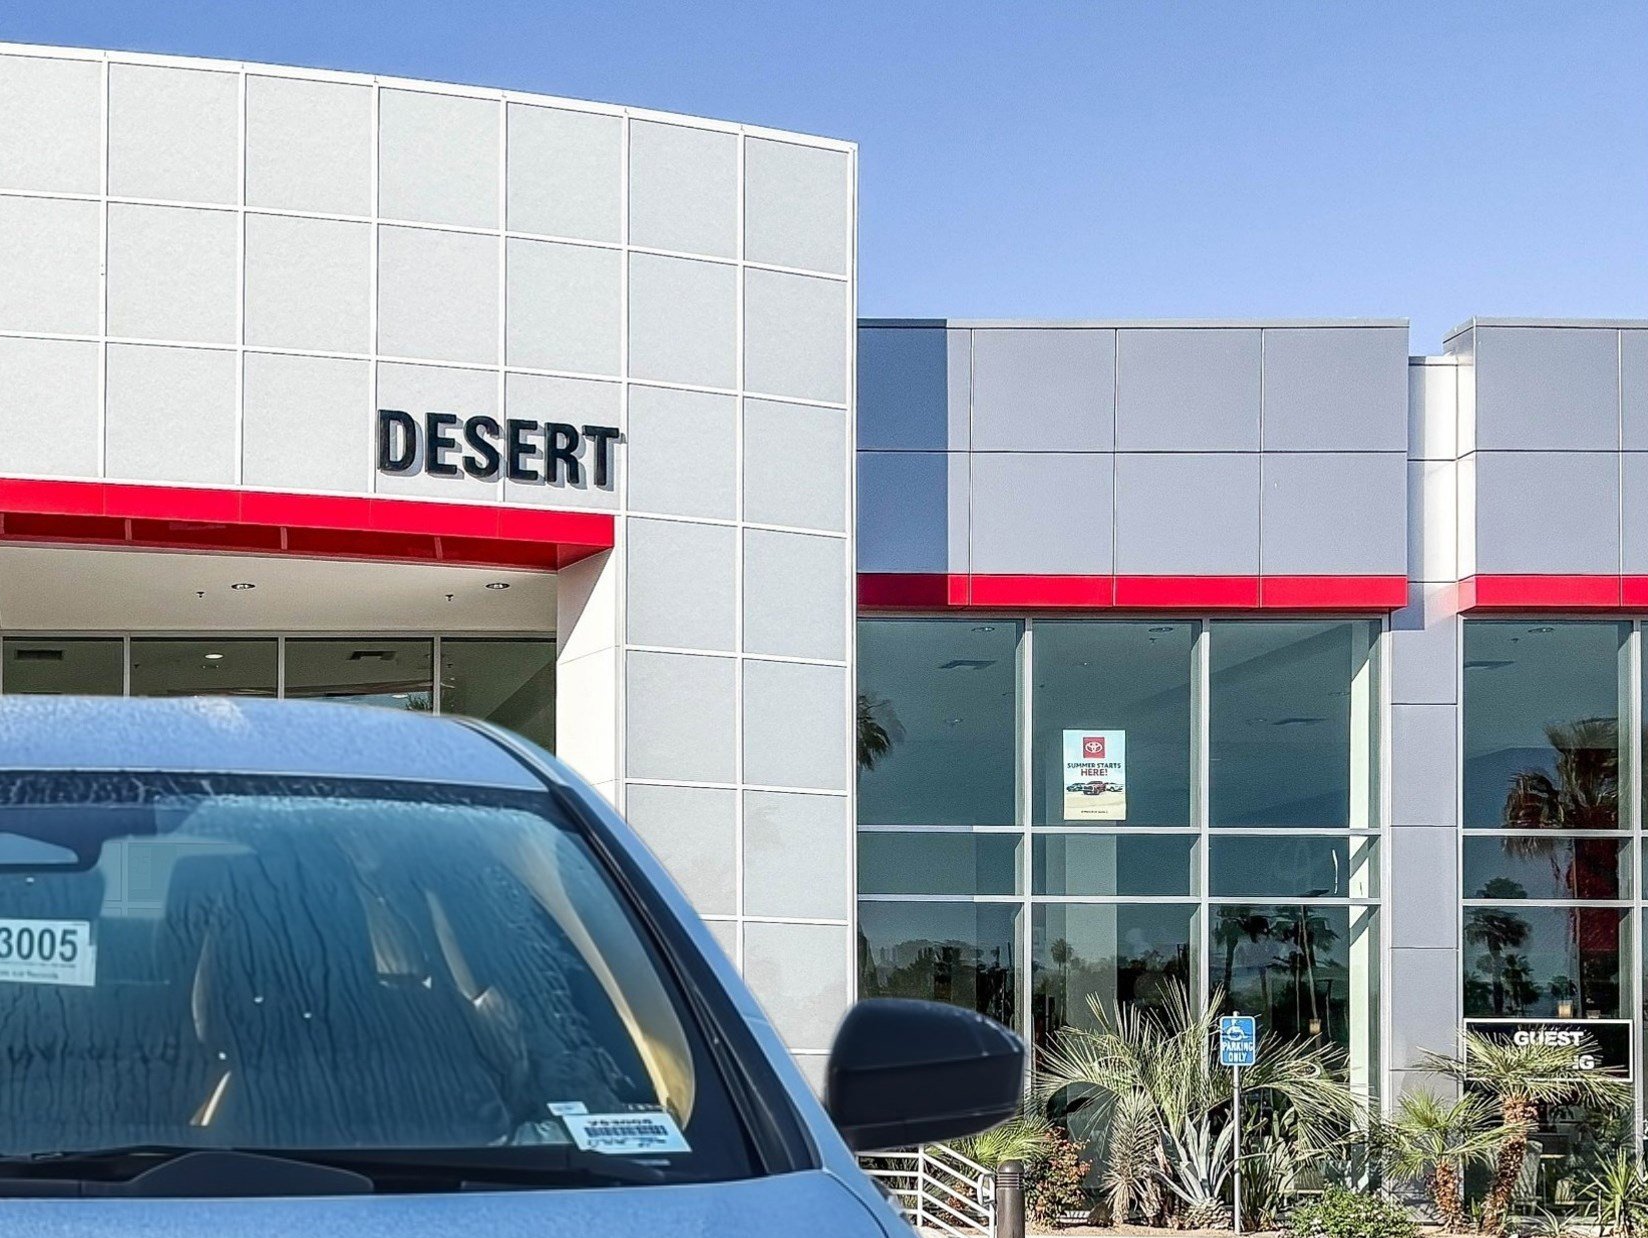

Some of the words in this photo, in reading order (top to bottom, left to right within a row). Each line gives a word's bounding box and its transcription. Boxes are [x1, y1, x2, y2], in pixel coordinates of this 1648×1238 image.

[377, 409, 620, 487] DESERT
[1080, 768, 1108, 776] HERE!
[1513, 1030, 1584, 1047] GUEST
[1222, 1041, 1253, 1052] PARKING
[1228, 1051, 1248, 1063] ONLY
